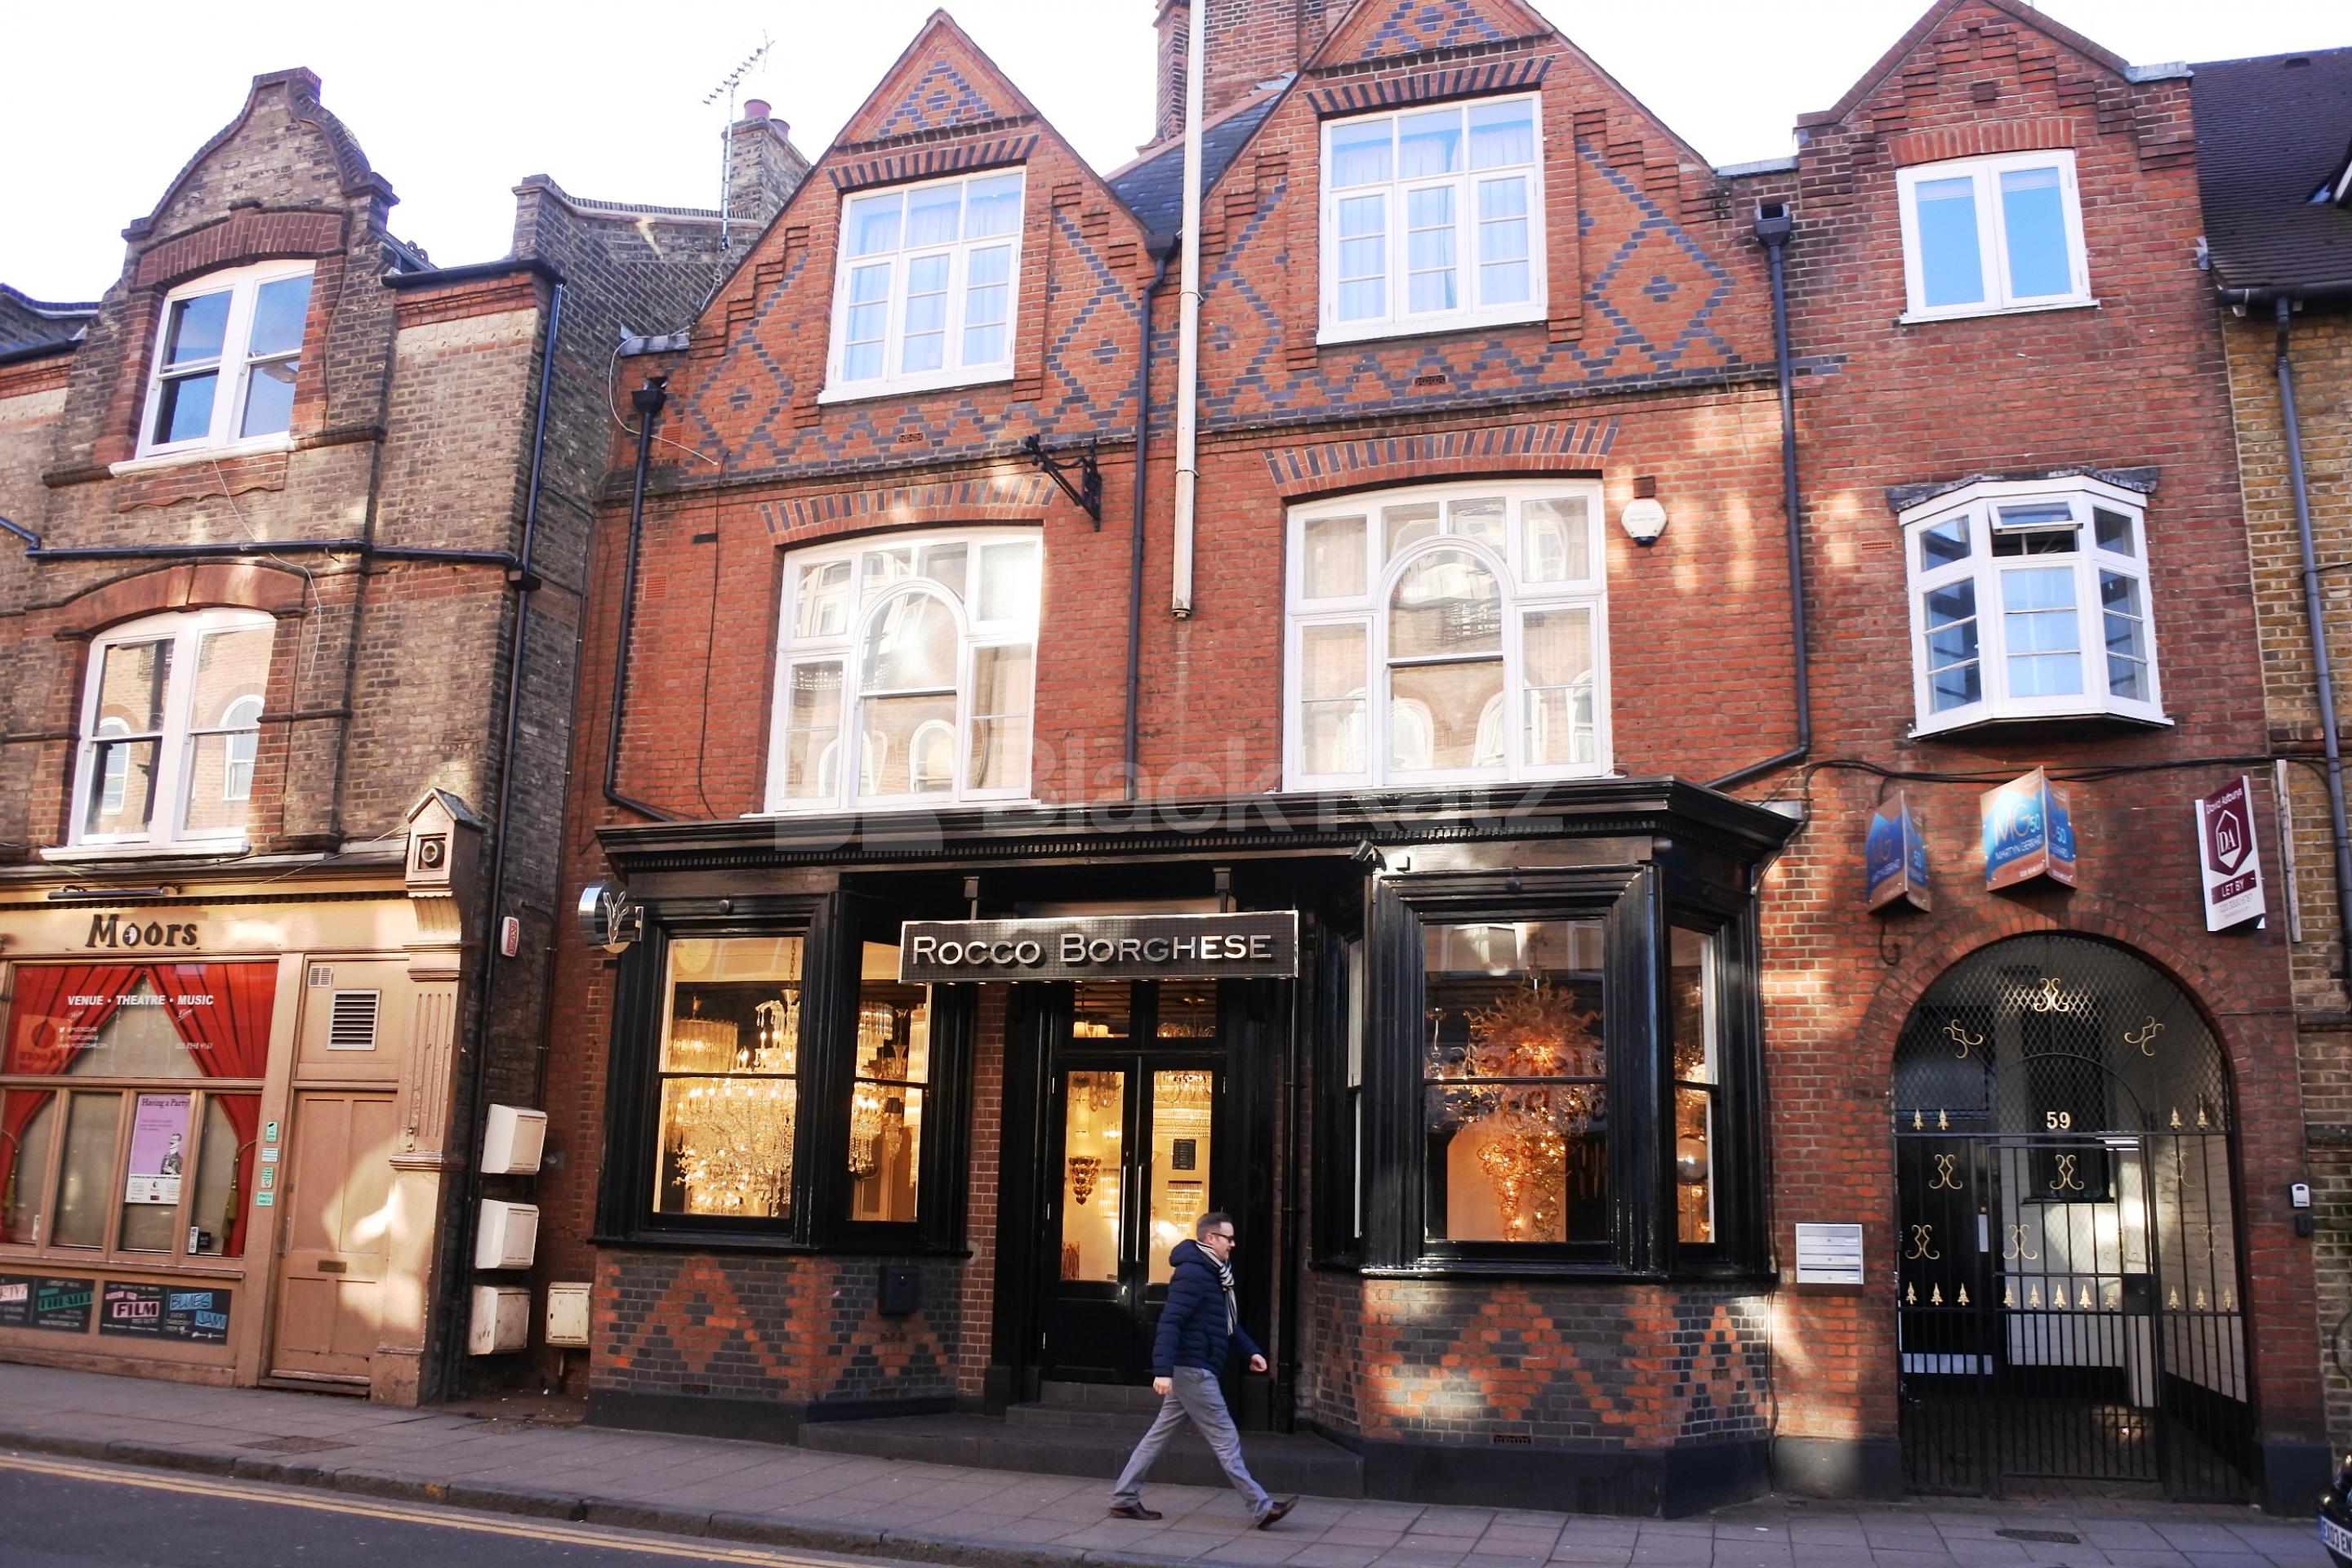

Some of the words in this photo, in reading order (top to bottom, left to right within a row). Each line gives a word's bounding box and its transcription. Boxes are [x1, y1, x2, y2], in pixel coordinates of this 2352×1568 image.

[2219, 828, 2237, 854] DA
[2221, 882, 2234, 898] LET
[2234, 878, 2245, 893] BY
[85, 913, 198, 948] Moors
[912, 936, 1040, 964] ROCCO
[1060, 933, 1272, 963] BORGHESE
[68, 995, 104, 1005] VENUE
[116, 995, 166, 1005] THEATRE
[177, 995, 214, 1005] MUSIC
[2047, 1111, 2071, 1129] 59
[117, 1303, 157, 1316] FILM
[172, 1294, 210, 1308] BLUES
